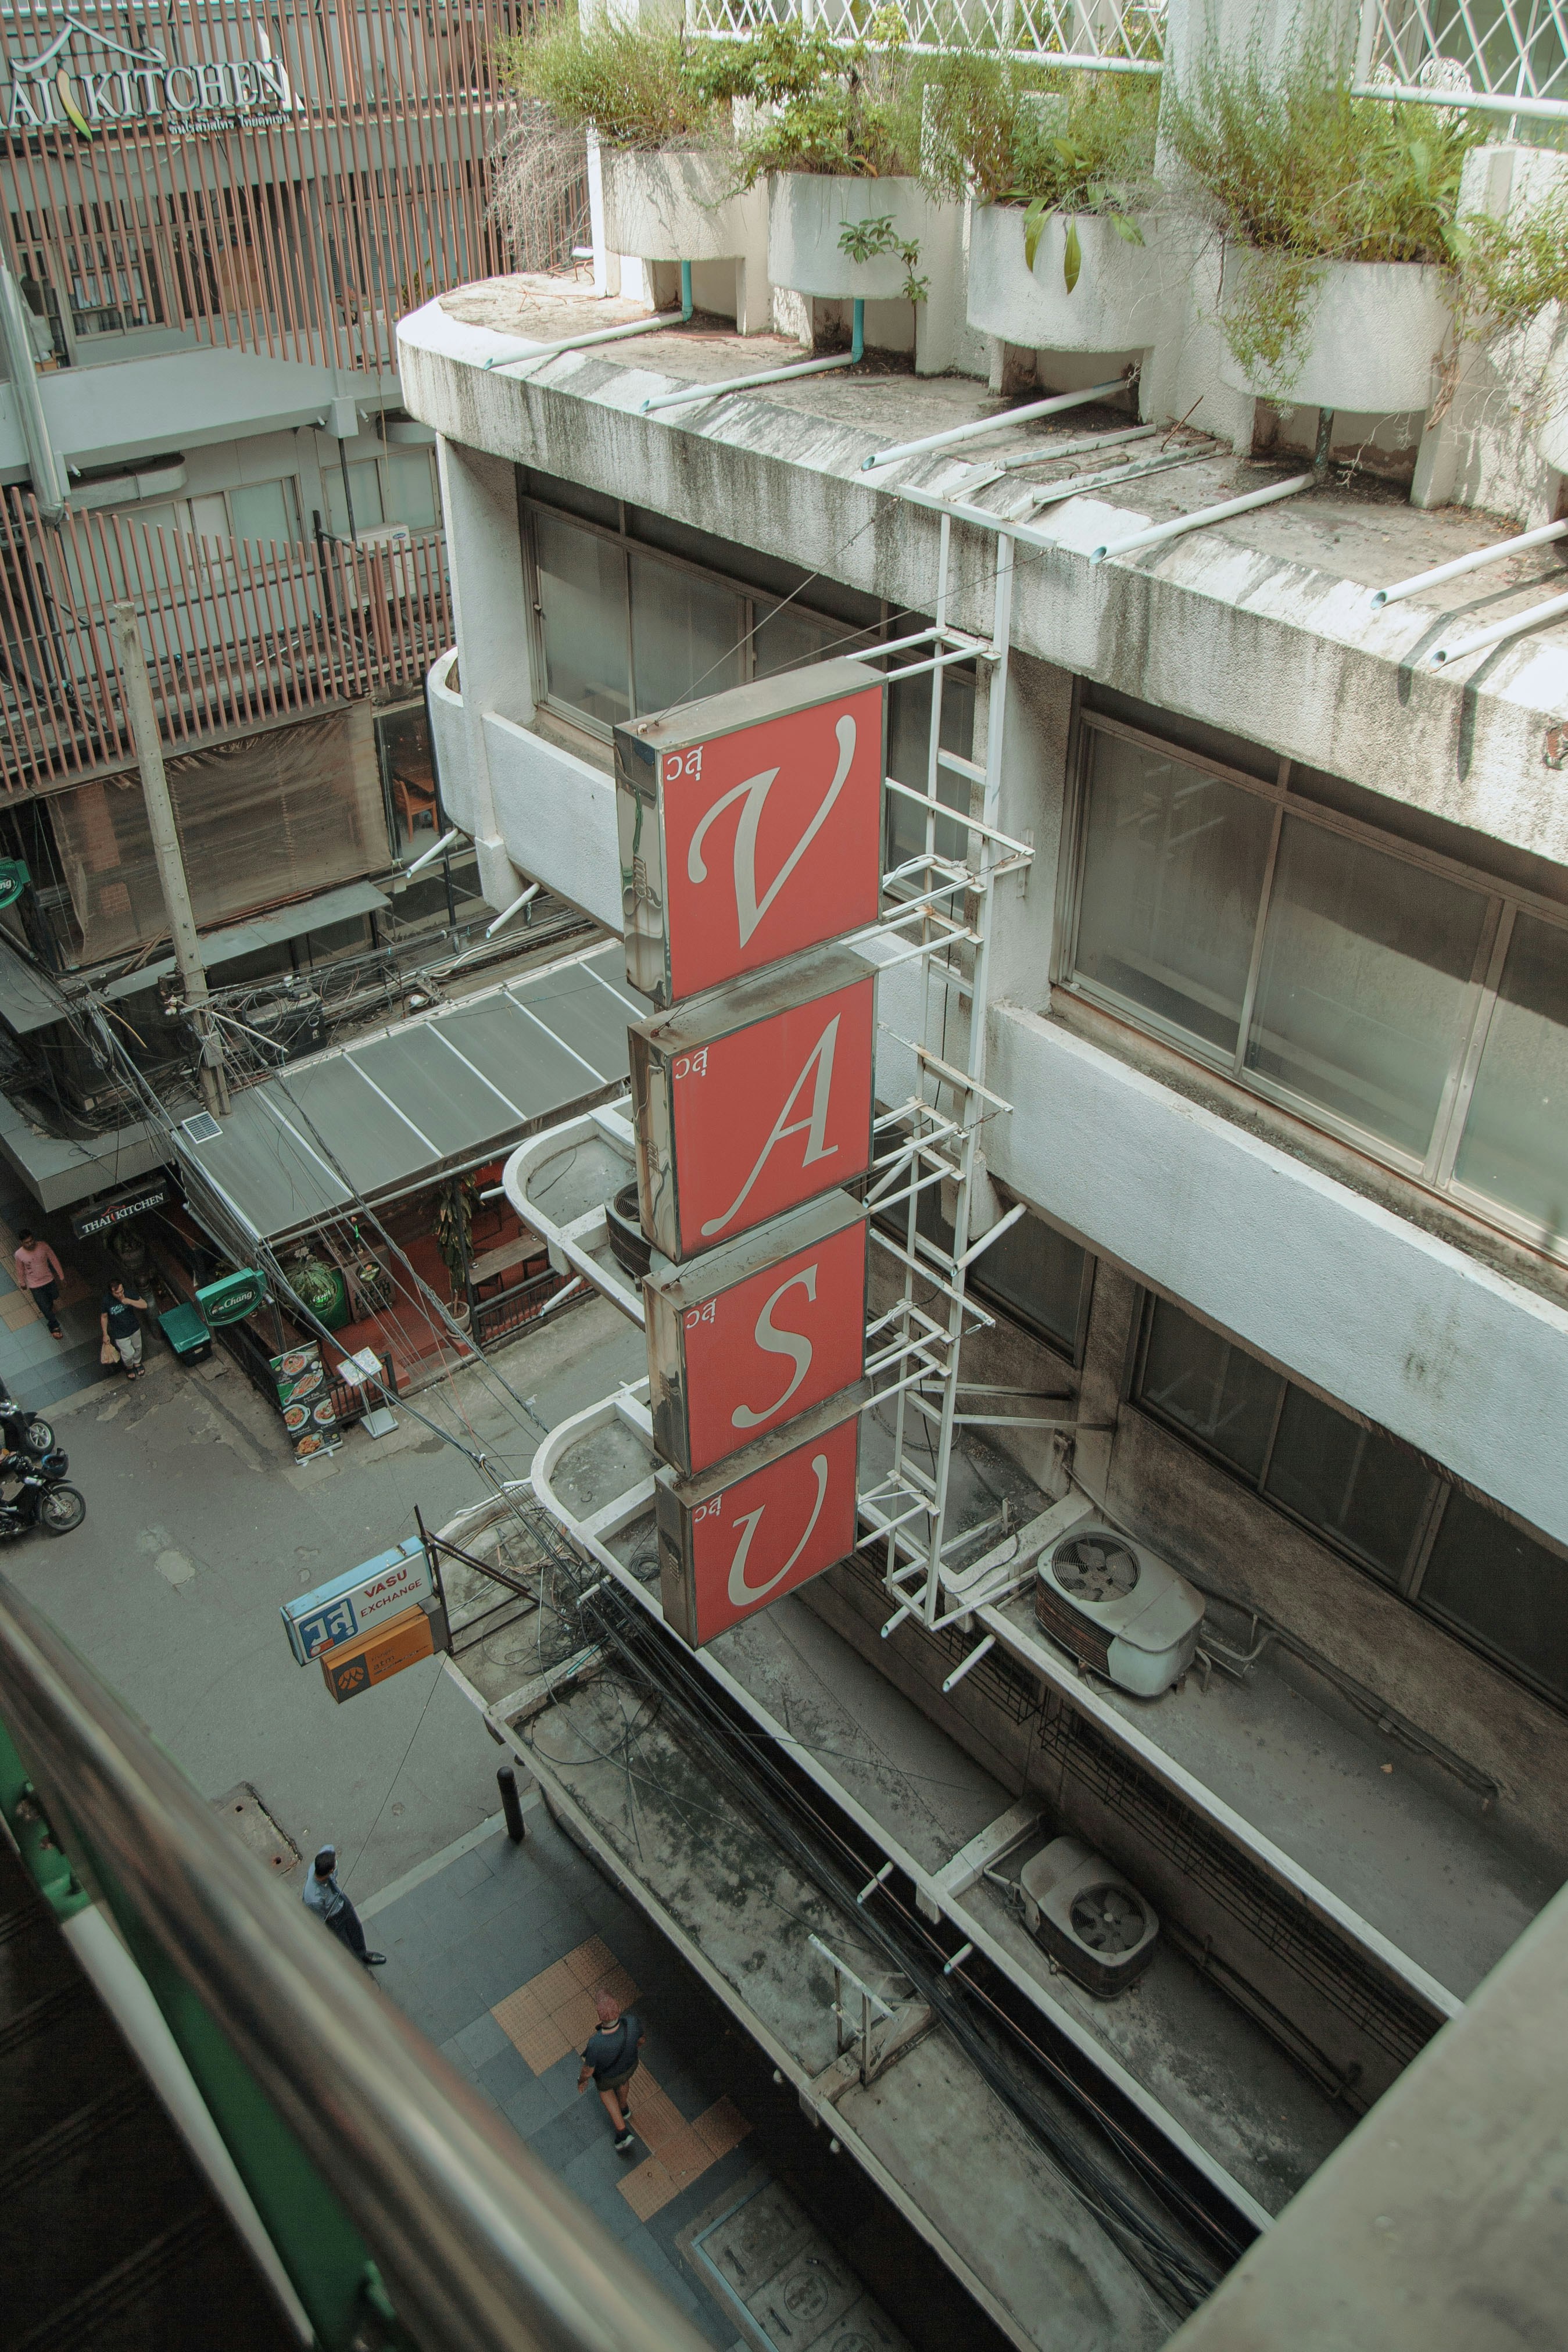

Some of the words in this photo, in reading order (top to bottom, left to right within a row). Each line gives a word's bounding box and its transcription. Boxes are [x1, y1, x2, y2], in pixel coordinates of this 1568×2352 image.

[80, 59, 287, 120] KITCHEN
[666, 746, 703, 781] วสุ
[675, 1047, 709, 1079] วสุ
[82, 1215, 112, 1233] THAI
[116, 1193, 164, 1220] KITCHEN
[224, 1291, 252, 1308] Chang
[686, 1298, 718, 1329] วสุ
[694, 1494, 723, 1522] วสุ
[360, 1578, 423, 1617] EXCHANGE
[364, 1569, 407, 1598] VASU
